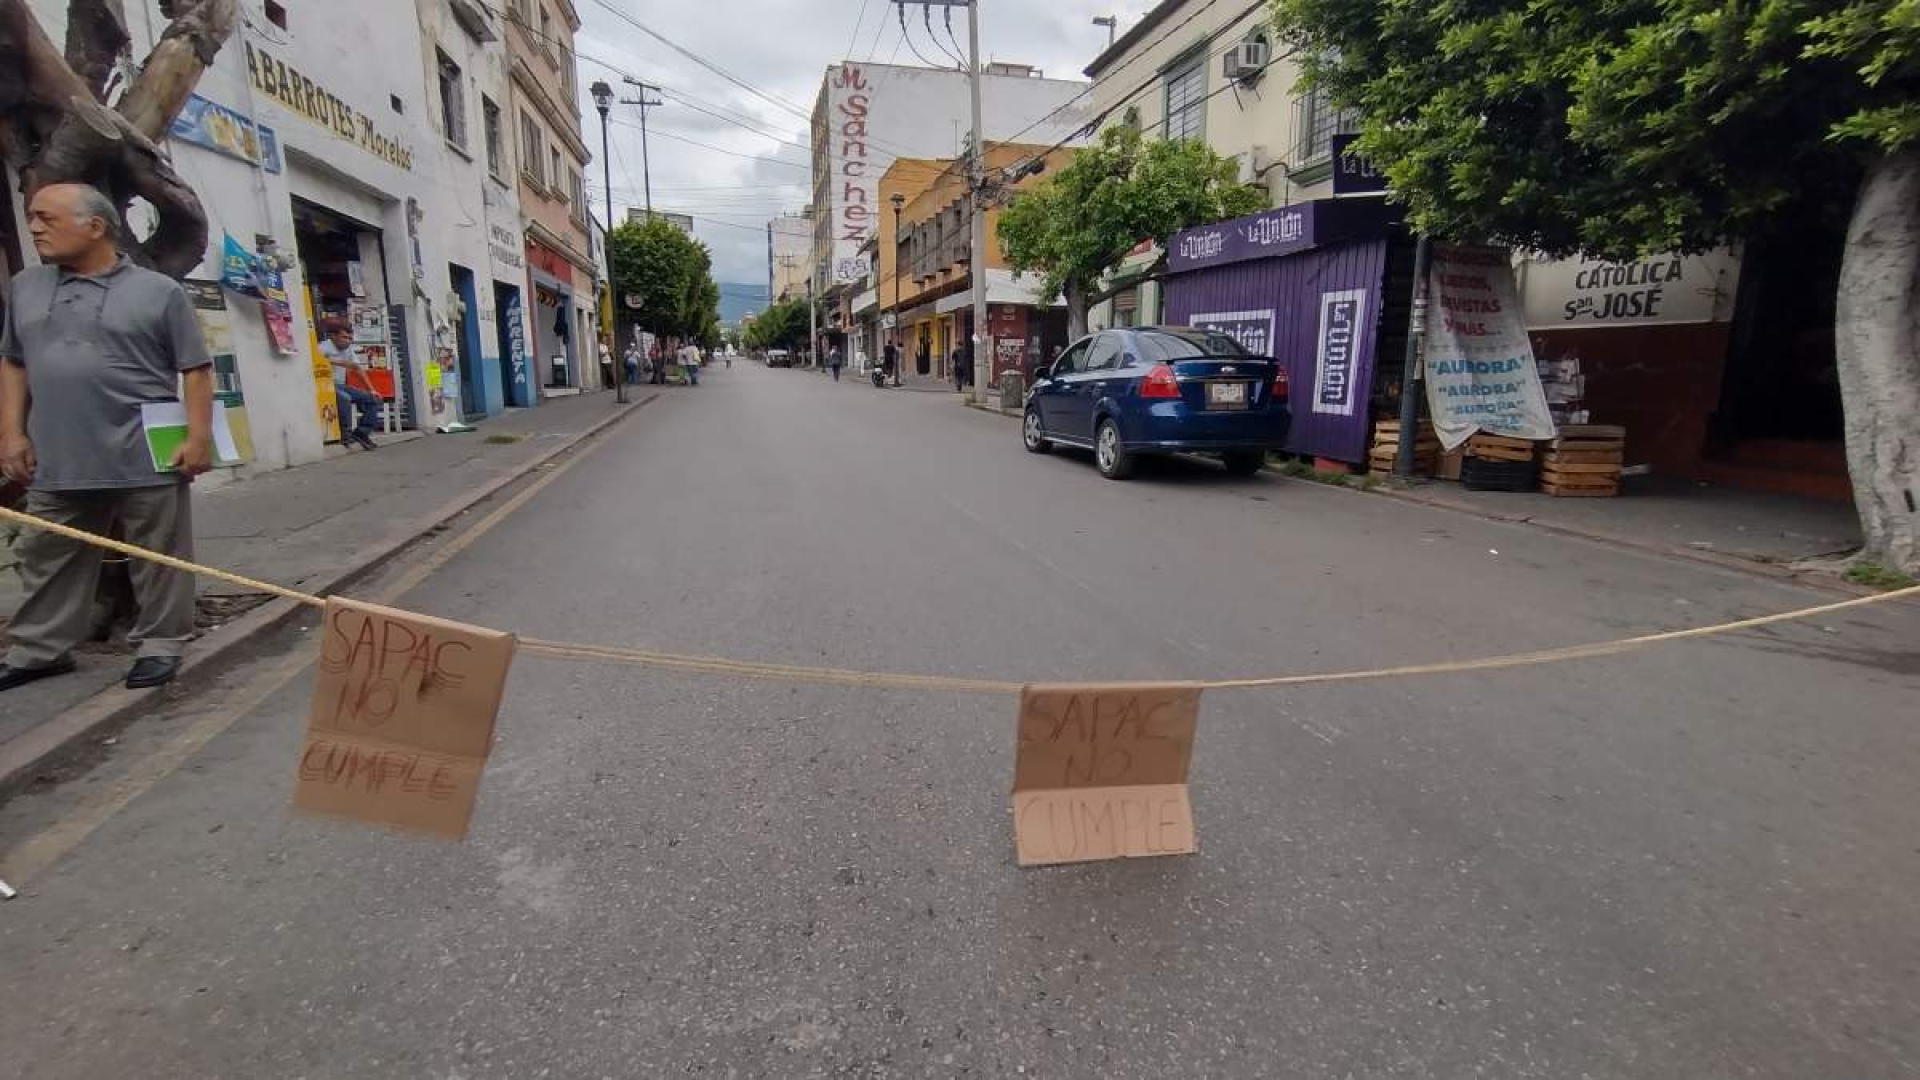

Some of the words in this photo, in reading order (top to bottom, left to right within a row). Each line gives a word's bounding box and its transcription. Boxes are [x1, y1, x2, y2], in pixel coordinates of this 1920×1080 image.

[245, 40, 356, 139] ABARROTES
[1564, 296, 1593, 321] San
[1593, 284, 1663, 319] JOSÉ
[506, 296, 526, 385] IMPRENTA
[321, 607, 472, 690] SAPAC
[333, 676, 400, 727] NO
[1023, 693, 1174, 743] SAPAC
[299, 740, 457, 799] CUMPLE
[1064, 748, 1132, 787] NO
[1020, 797, 1185, 860] CUMPLE
